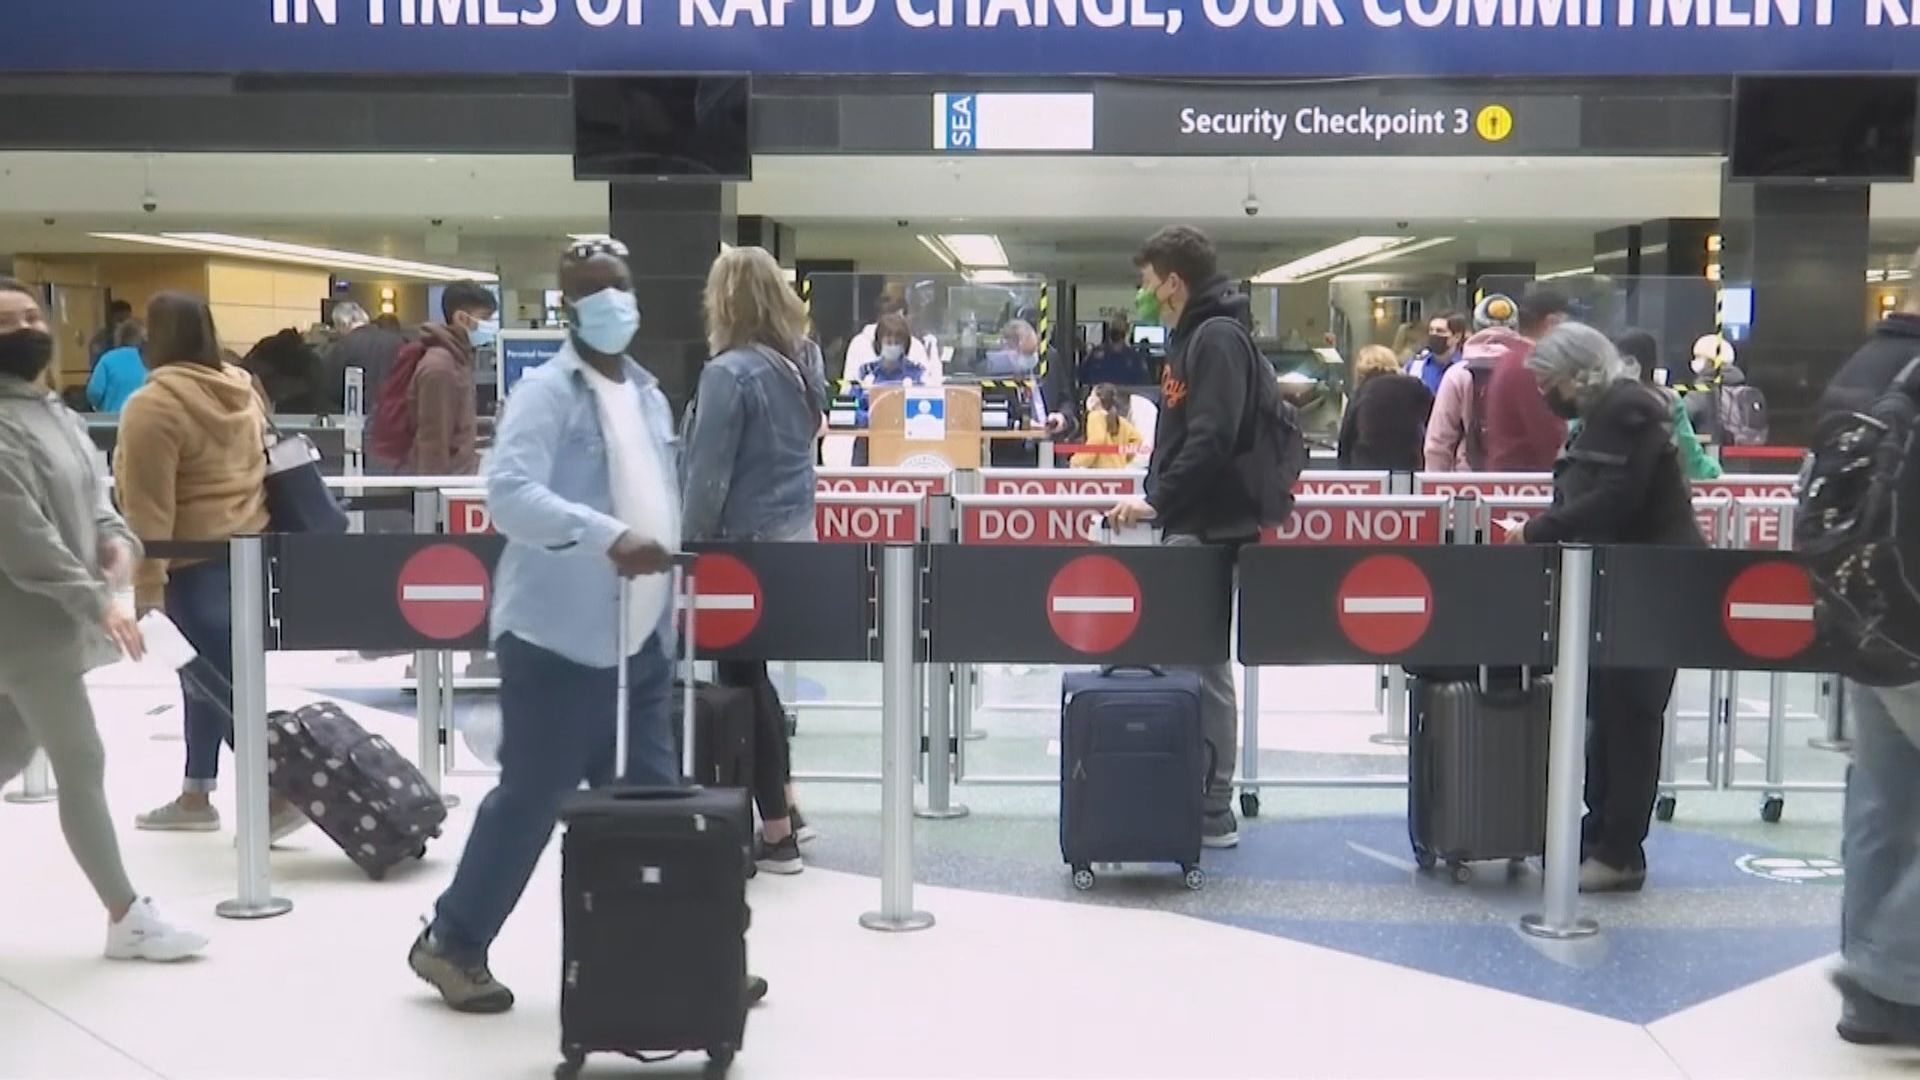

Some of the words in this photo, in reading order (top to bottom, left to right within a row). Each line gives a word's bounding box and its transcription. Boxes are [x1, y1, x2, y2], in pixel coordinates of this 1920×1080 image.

[952, 95, 971, 147] SEA
[1180, 107, 1287, 140] Security
[1295, 105, 1444, 141] Checkpoint
[1453, 108, 1469, 134] 3
[465, 504, 491, 533] D
[824, 507, 902, 538] NOT
[979, 509, 1035, 540] DO
[1048, 510, 1107, 540] NO
[1345, 510, 1426, 540] NOT
